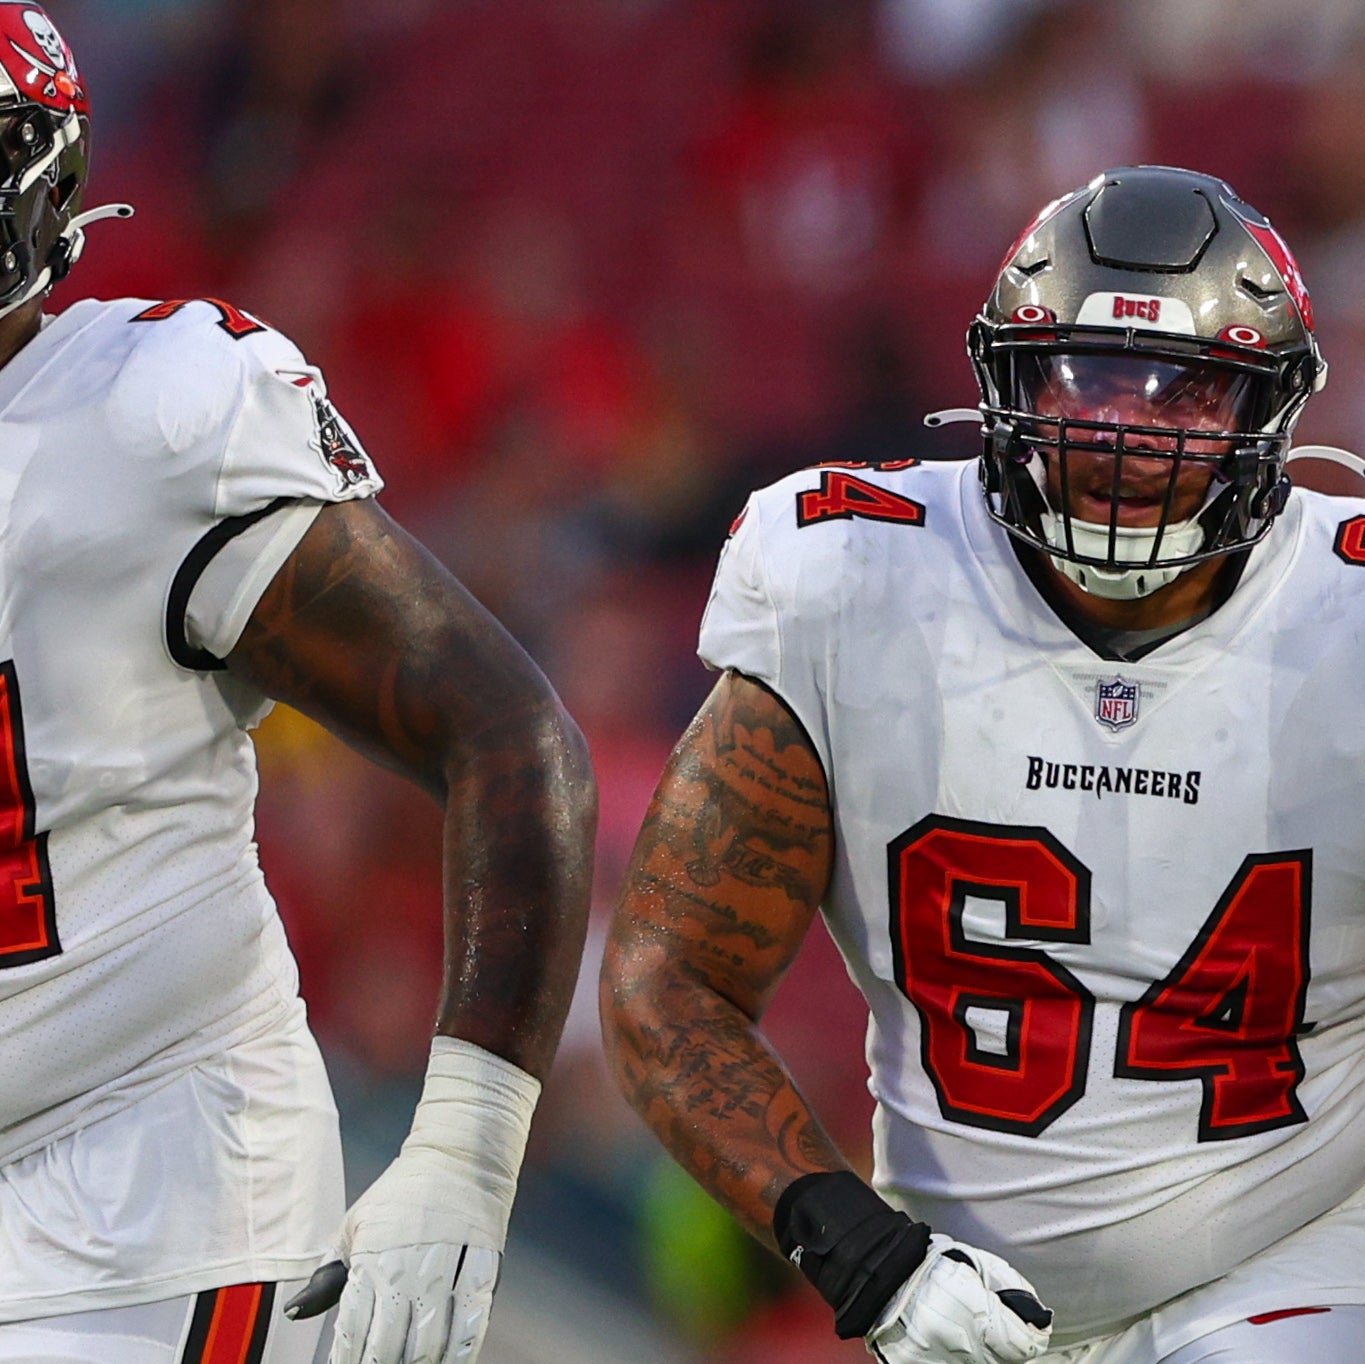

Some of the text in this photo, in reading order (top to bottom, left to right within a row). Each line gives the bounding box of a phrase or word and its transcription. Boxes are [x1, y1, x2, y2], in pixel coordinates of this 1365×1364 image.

[1102, 700, 1131, 721] NFL
[1026, 756, 1201, 805] BUCCANEERS
[887, 813, 1314, 1142] 64
